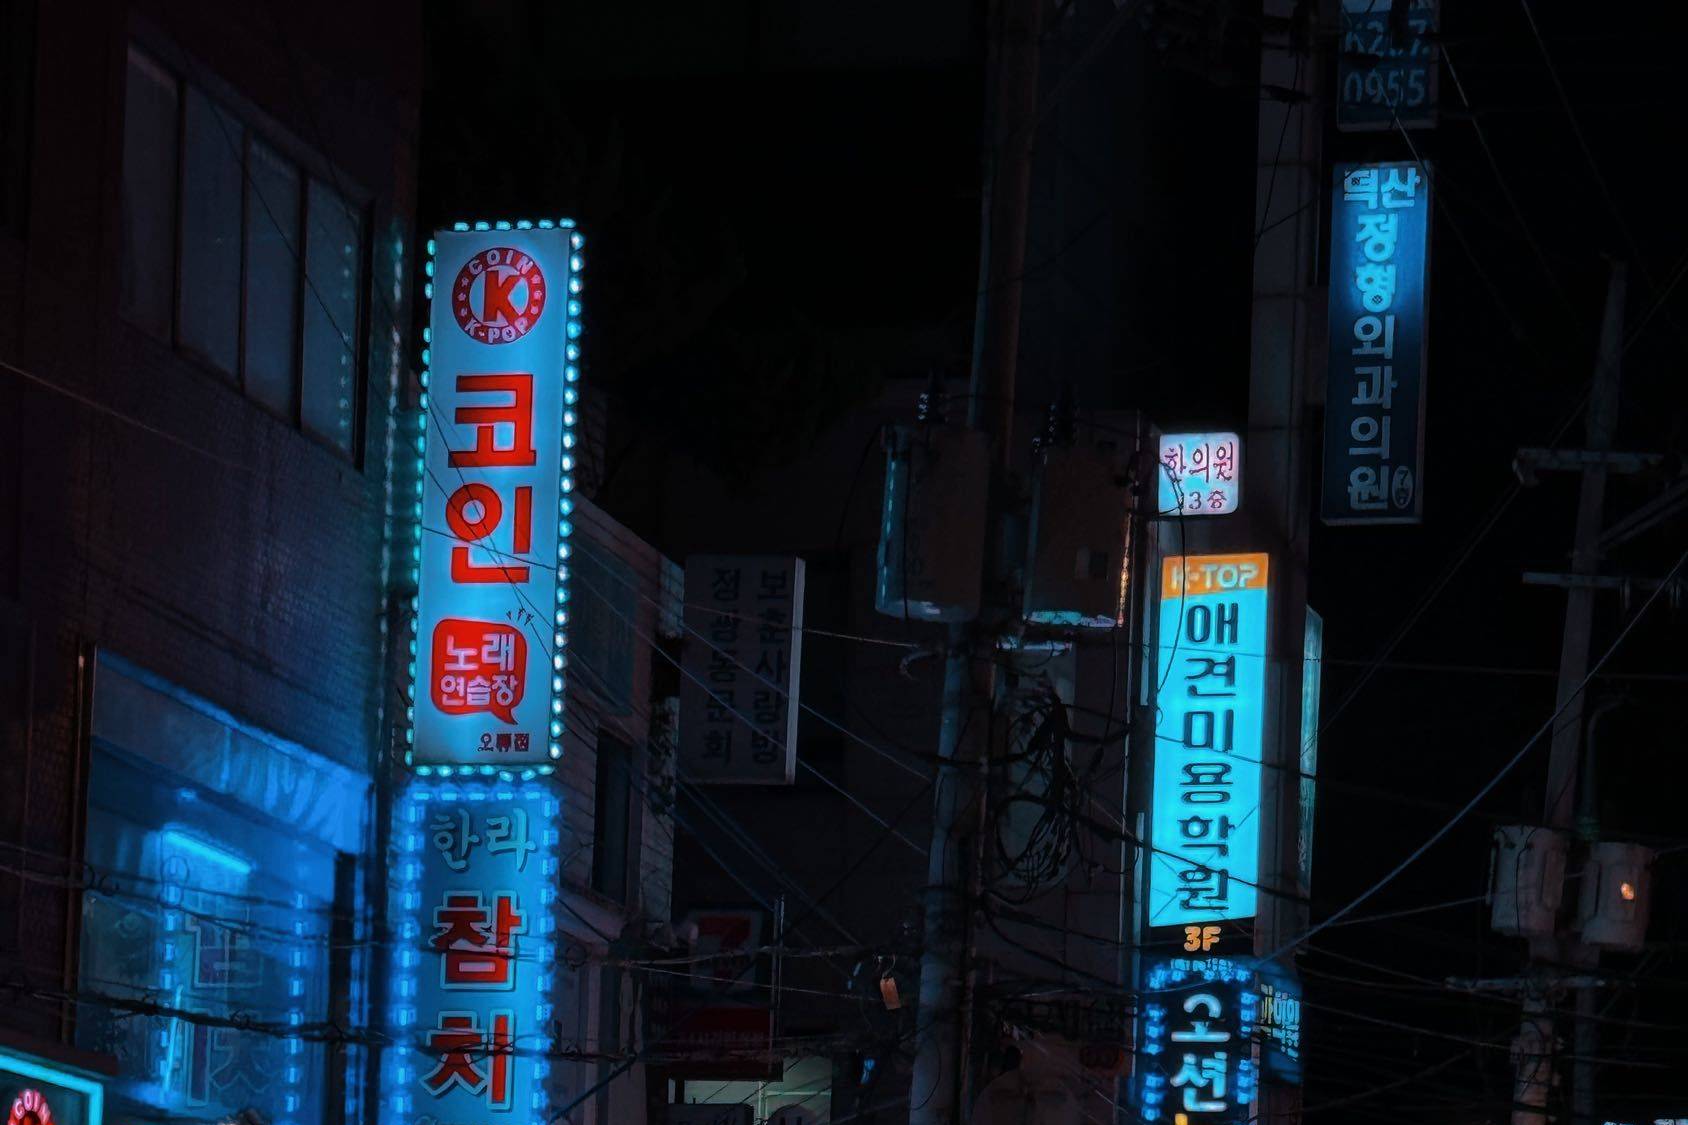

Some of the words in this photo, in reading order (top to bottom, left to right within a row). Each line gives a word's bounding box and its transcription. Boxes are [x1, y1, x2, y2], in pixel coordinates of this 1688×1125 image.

[469, 249, 534, 276] COIN
[1348, 213, 1398, 511] 정형외과의원
[445, 374, 536, 583] 코인
[440, 674, 518, 706] 연습장
[444, 632, 515, 672] 노래
[1176, 603, 1238, 911] 애견미용학원
[419, 889, 527, 1112] 참치
[1183, 926, 1221, 952] 3F
